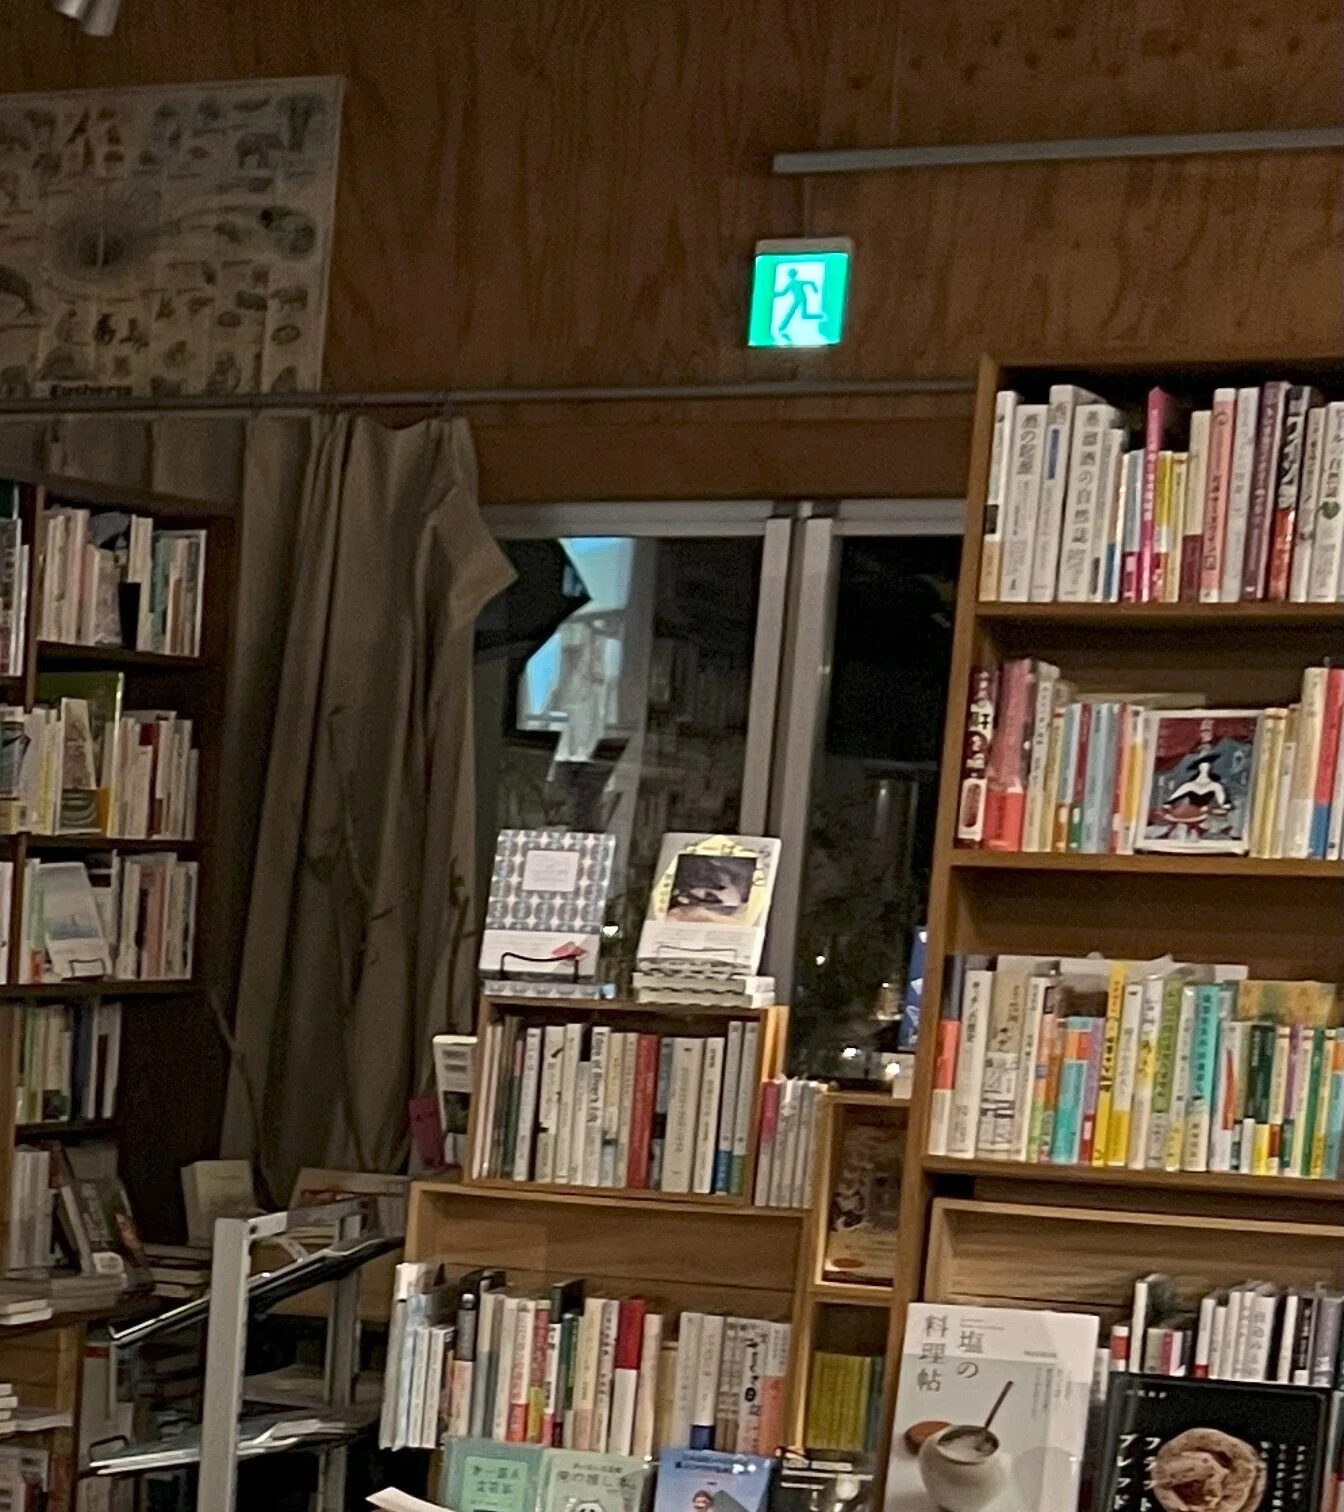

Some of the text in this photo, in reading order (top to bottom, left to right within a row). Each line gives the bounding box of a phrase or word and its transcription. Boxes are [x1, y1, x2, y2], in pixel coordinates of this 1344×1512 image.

[914, 1313, 951, 1394] 料理帖
[955, 1329, 985, 1380] 塩の
